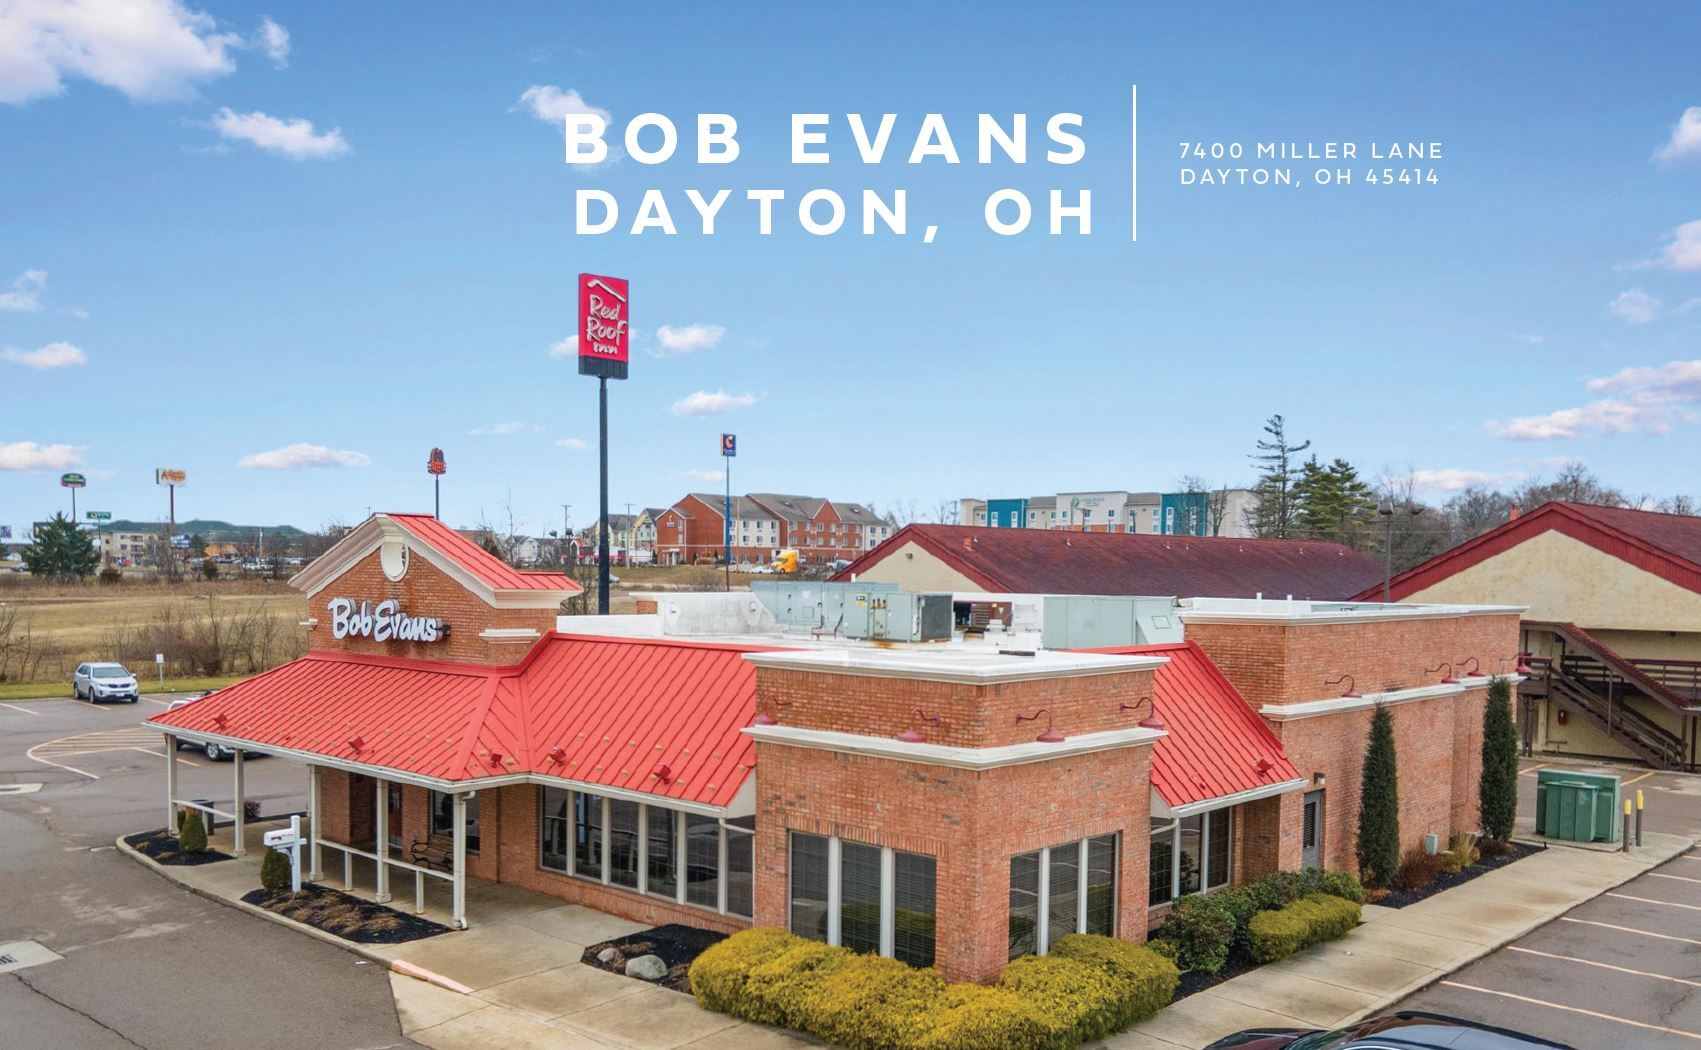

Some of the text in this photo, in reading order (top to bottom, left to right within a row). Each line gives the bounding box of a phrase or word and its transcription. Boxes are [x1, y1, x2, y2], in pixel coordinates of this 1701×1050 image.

[589, 294, 622, 321] Red
[586, 315, 628, 346] Roof
[327, 596, 440, 643] Bob Evans
